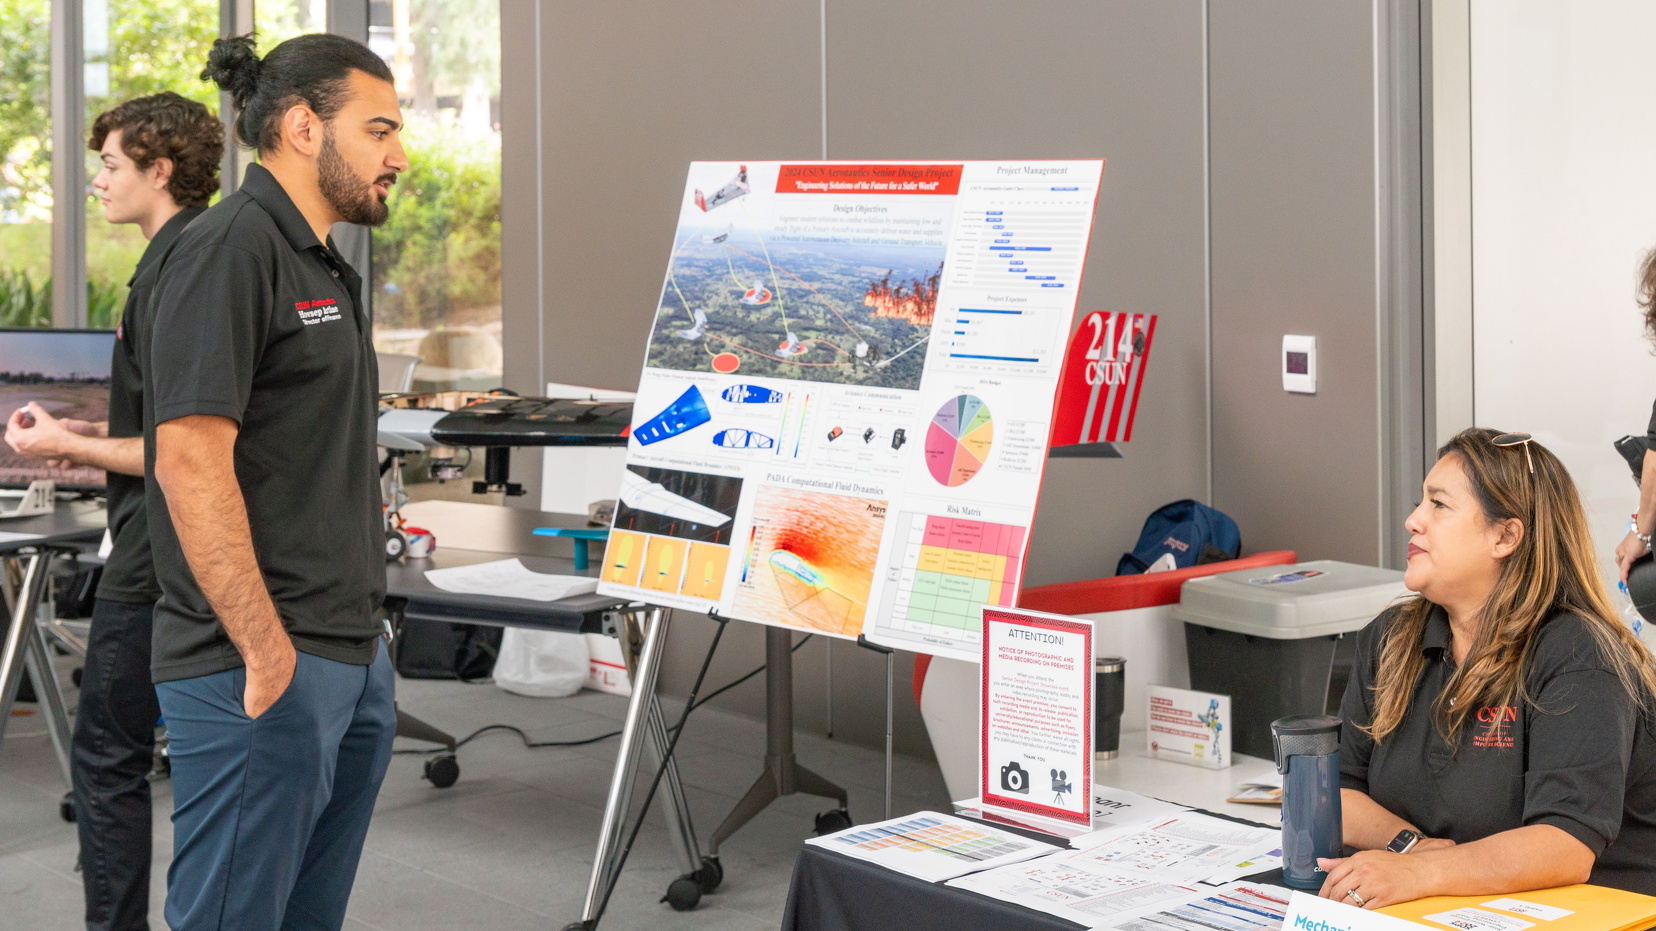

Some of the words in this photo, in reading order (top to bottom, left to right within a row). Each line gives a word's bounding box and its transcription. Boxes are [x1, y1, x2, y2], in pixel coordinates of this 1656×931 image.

[784, 167, 801, 177] 2024
[802, 167, 823, 177] CSUN
[827, 168, 869, 177] Aeronautics
[872, 168, 894, 177] Senior
[897, 168, 921, 178] Design
[924, 168, 953, 178] Project
[997, 166, 1020, 175] Project
[1024, 166, 1067, 175] Management
[828, 181, 853, 189] Solutions
[854, 181, 860, 189] of
[860, 181, 869, 189] the
[870, 181, 887, 189] Future
[902, 182, 917, 190] Safer
[833, 204, 853, 212] Design
[855, 205, 887, 214] Objectives
[1085, 313, 1134, 362] 214
[1085, 361, 1128, 386] CSUN
[766, 473, 786, 483] PADA
[787, 475, 834, 490] Computational
[835, 481, 852, 491] Fluid
[853, 483, 884, 495] Dynamics
[866, 504, 886, 513] Ansys
[947, 505, 960, 514] Risk
[962, 506, 981, 516] Matrix
[1008, 628, 1063, 645] ATTENTION!
[1024, 650, 1061, 661] PHOTOGRAPHIC
[1014, 656, 1040, 665] RECORDING
[1051, 662, 1074, 670] PREMISES
[1477, 706, 1518, 722] CSN
[1294, 913, 1352, 931] Mech
